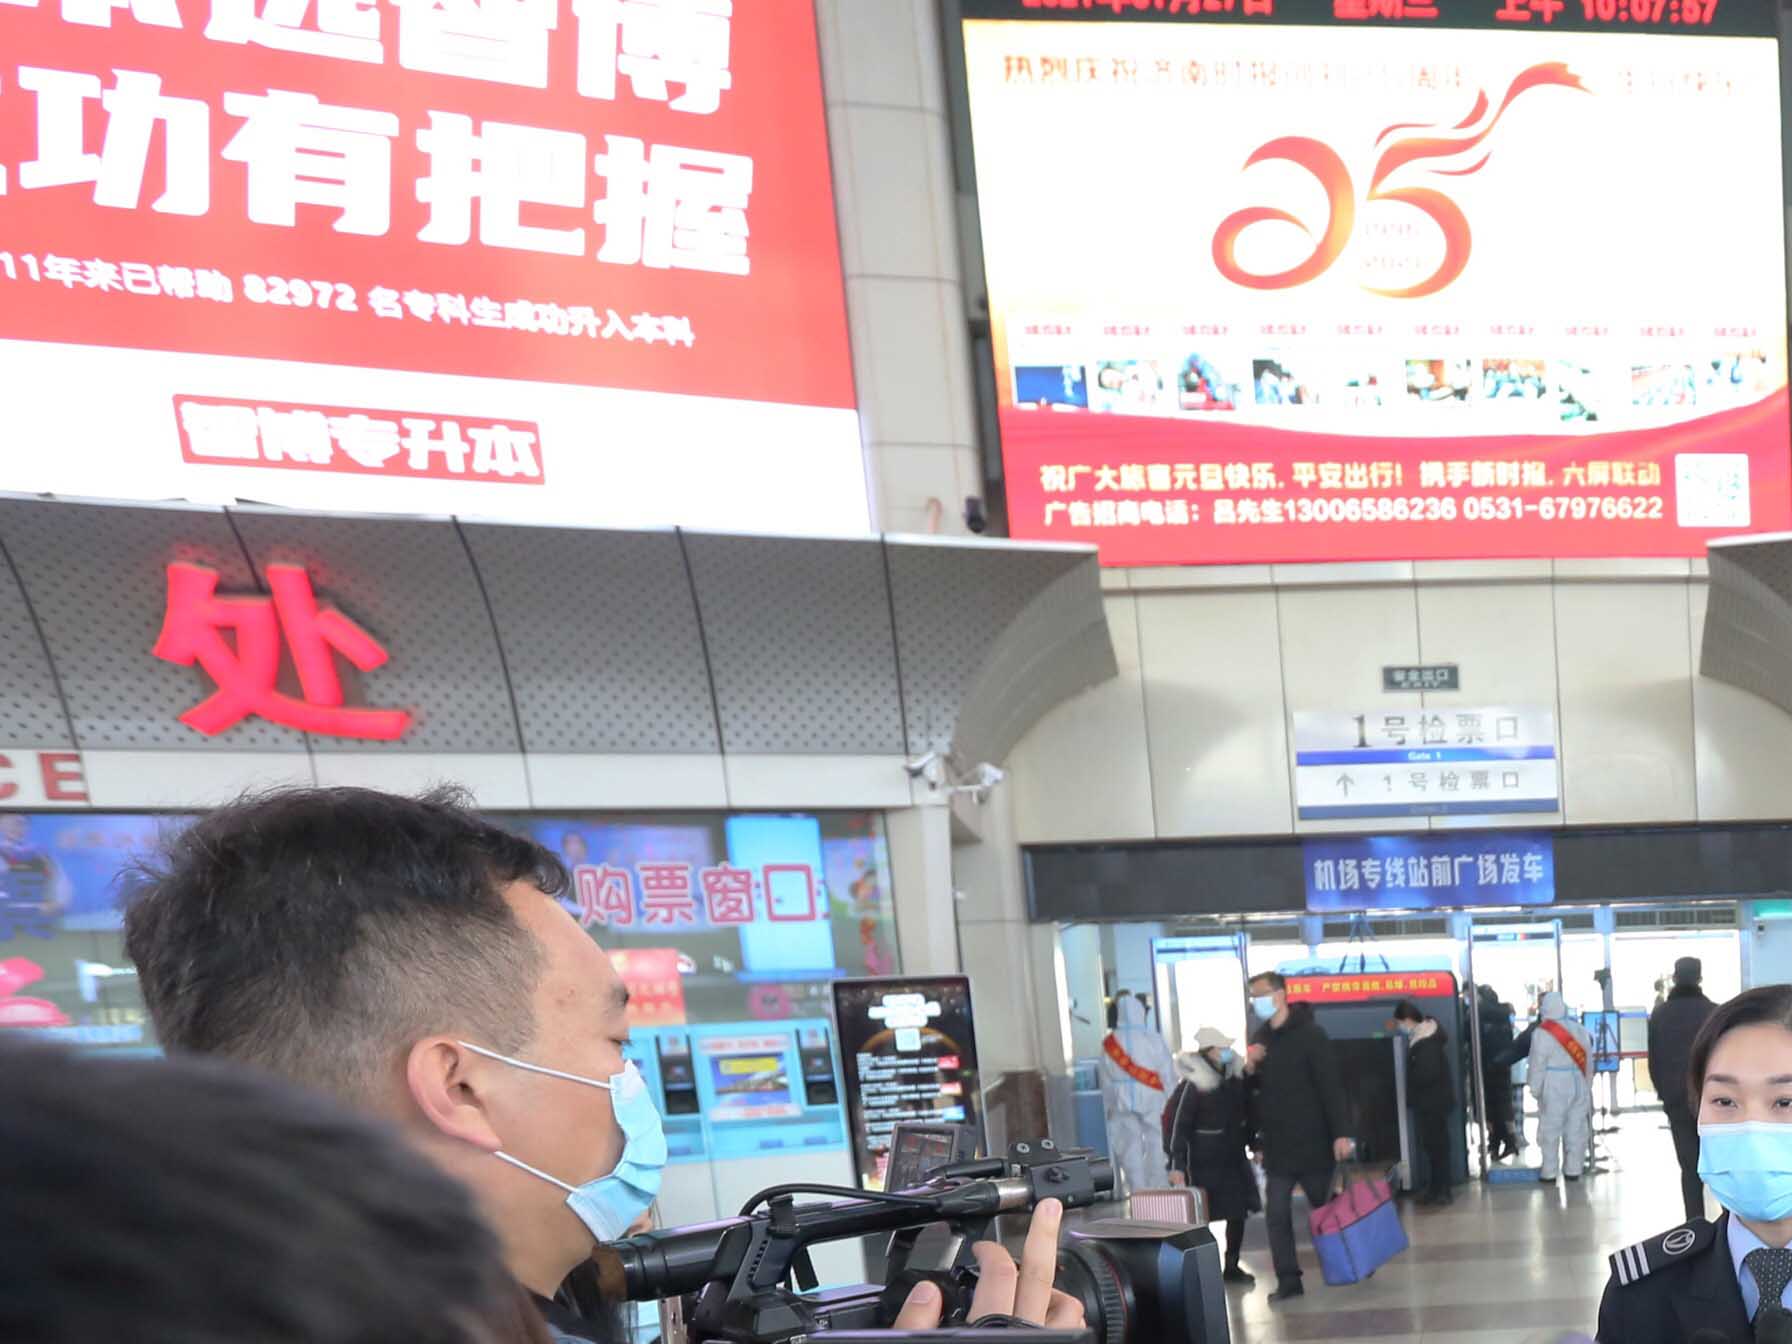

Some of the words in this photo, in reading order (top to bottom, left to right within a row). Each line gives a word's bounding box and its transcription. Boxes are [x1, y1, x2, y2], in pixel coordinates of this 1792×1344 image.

[0, 0, 731, 114] 智博
[0, 65, 753, 275] 功有把握
[1463, 495, 1664, 520] 0531-67976622
[1353, 713, 1520, 748] 1号检票口
[1313, 852, 1544, 891] 机场专线站前广场发车
